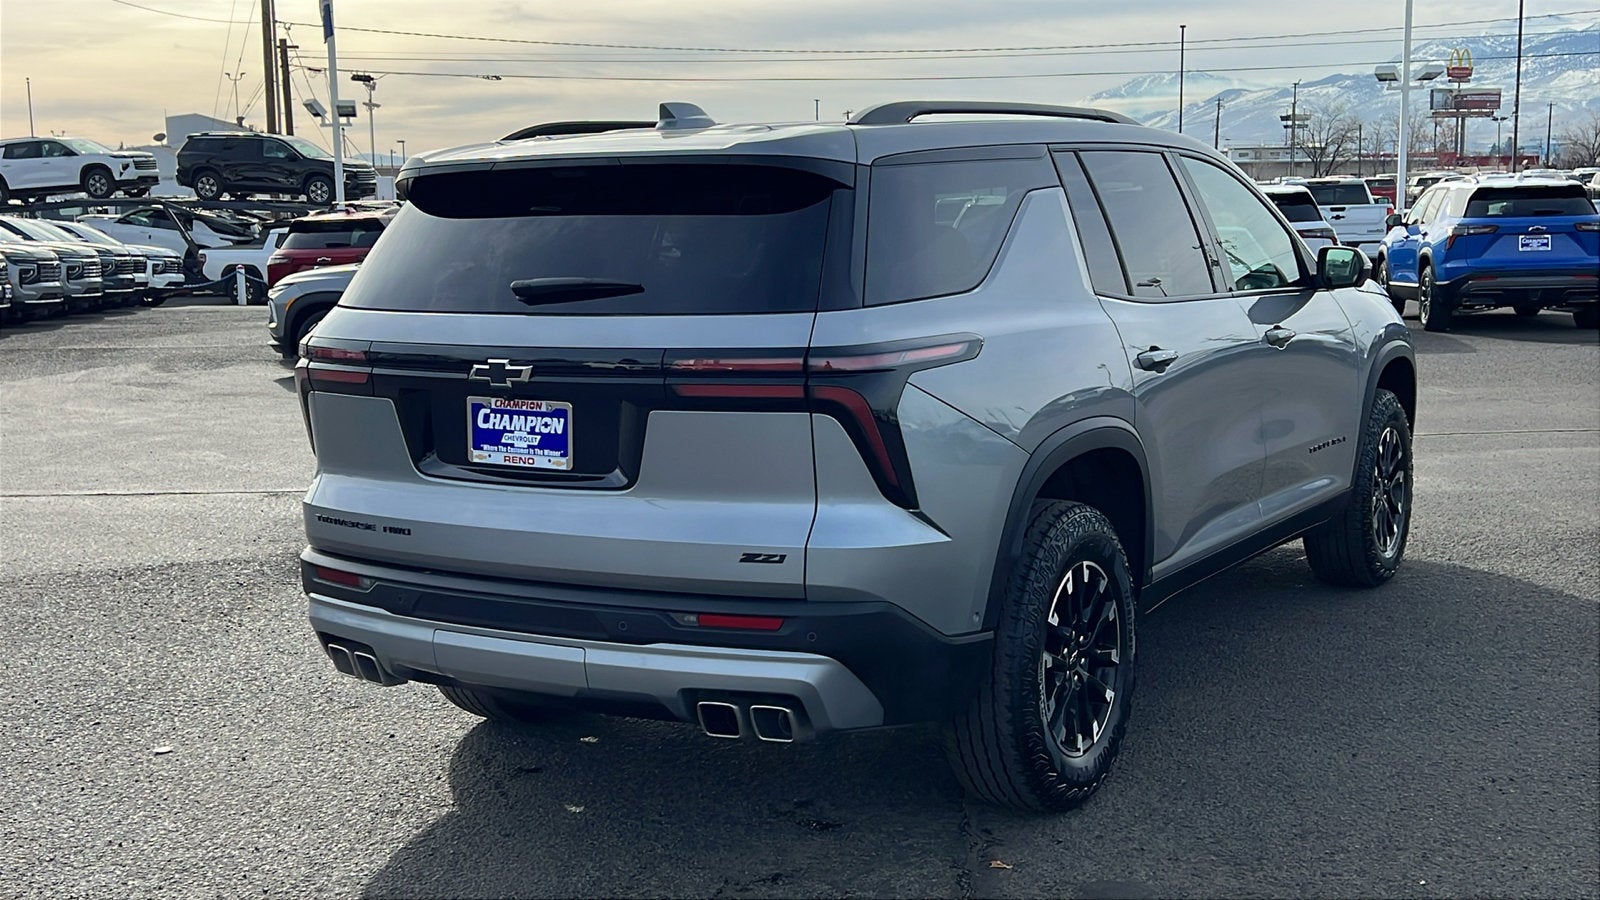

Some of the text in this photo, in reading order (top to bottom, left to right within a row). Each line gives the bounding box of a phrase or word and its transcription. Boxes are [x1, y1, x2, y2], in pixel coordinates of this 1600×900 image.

[494, 399, 542, 410] CHAMPION
[477, 408, 565, 434] CHAMPION
[503, 434, 538, 443] CHEVROLET
[503, 455, 535, 465] RENO
